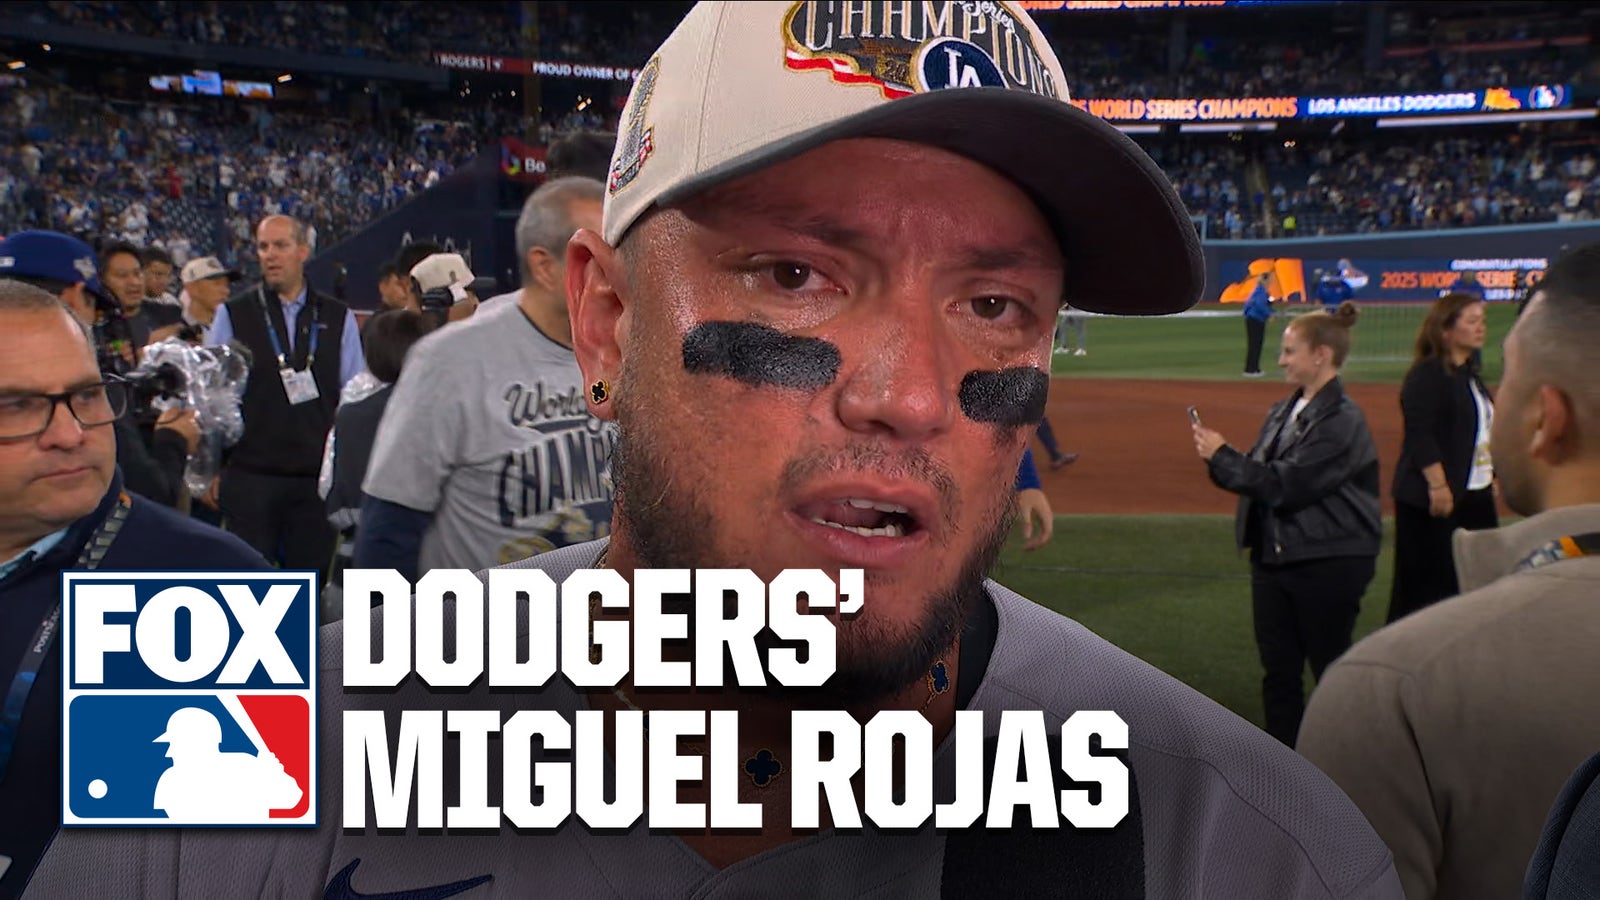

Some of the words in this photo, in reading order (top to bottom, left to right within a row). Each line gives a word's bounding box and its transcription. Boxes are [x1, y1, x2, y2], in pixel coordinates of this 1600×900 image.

[440, 54, 485, 70] ROGERS
[533, 61, 572, 76] PROUD
[573, 65, 614, 80] OWNER
[615, 69, 633, 81] OF
[943, 46, 983, 88] LA
[1089, 99, 1145, 119] WORLD
[1146, 99, 1197, 119] SERIES
[1198, 97, 1298, 118] CHAMPIONS
[1308, 98, 1336, 115] LOS
[1336, 95, 1401, 114] ANGELES
[1403, 92, 1477, 111] DODGERS
[1381, 271, 1419, 288] 2025
[1476, 270, 1518, 289] SERIE
